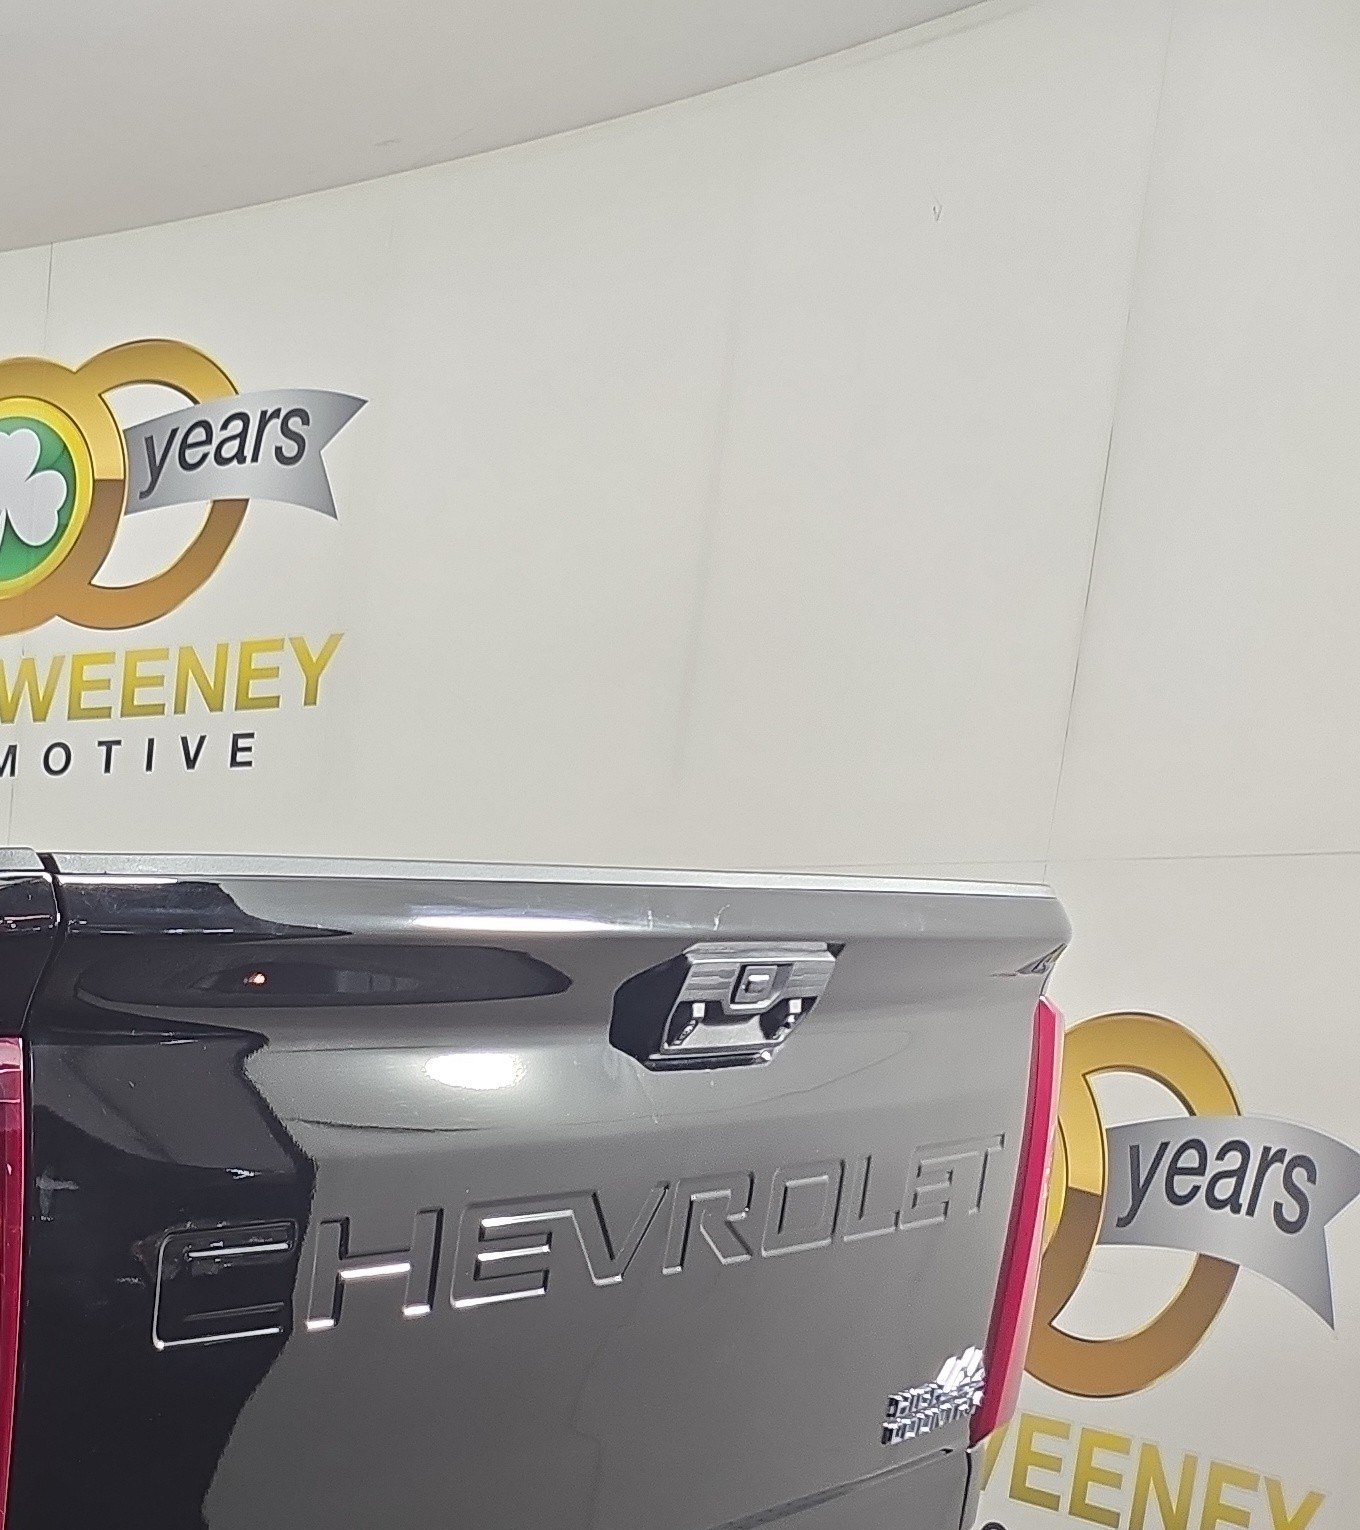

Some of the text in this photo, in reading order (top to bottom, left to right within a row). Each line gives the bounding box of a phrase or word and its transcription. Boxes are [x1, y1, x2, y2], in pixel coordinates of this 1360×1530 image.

[138, 399, 311, 499] years
[1116, 1136, 1318, 1236] years
[151, 1132, 1005, 1351] CHEVROLET
